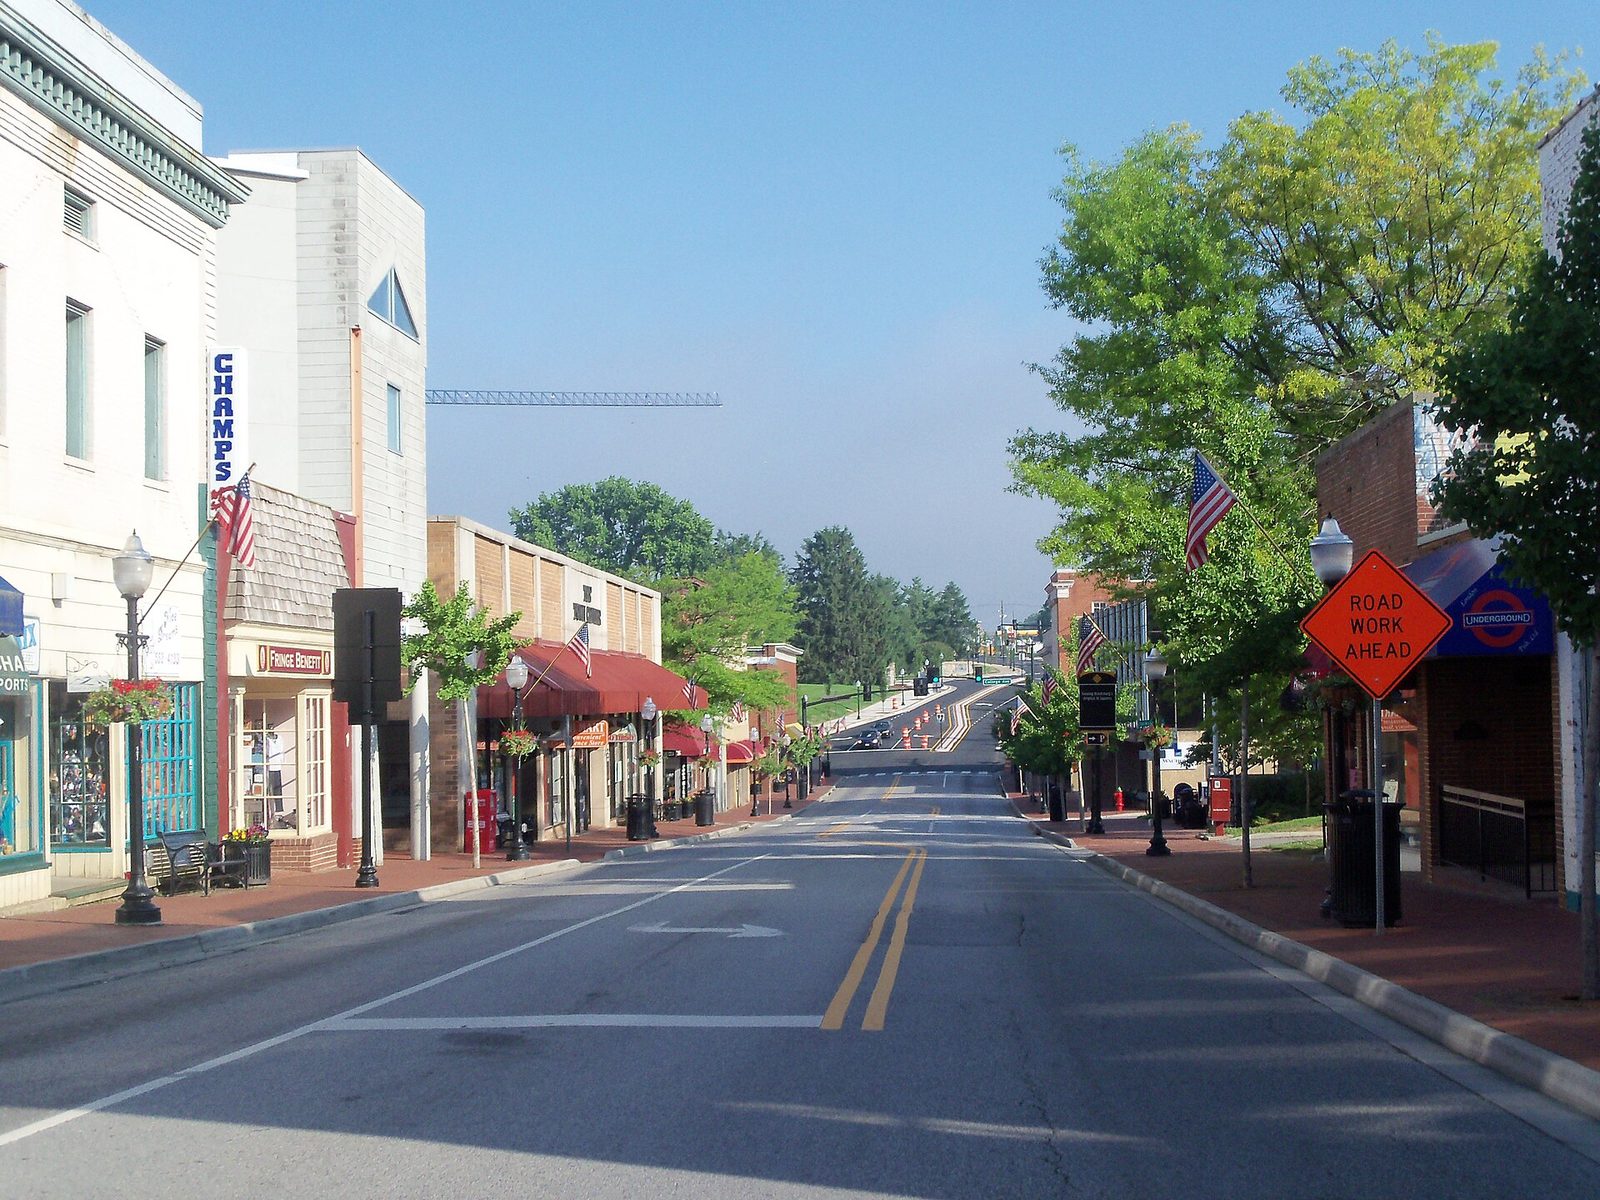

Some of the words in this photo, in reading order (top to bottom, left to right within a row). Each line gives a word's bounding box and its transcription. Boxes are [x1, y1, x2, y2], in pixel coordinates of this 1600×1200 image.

[213, 353, 233, 481] CHAMPS
[1350, 593, 1403, 611] ROAD
[1350, 616, 1403, 634] WORK
[1465, 613, 1531, 625] UNDERGROUND
[270, 649, 295, 668] FRINGE
[295, 651, 322, 670] BENEFIT
[1345, 641, 1411, 660] AHEAD
